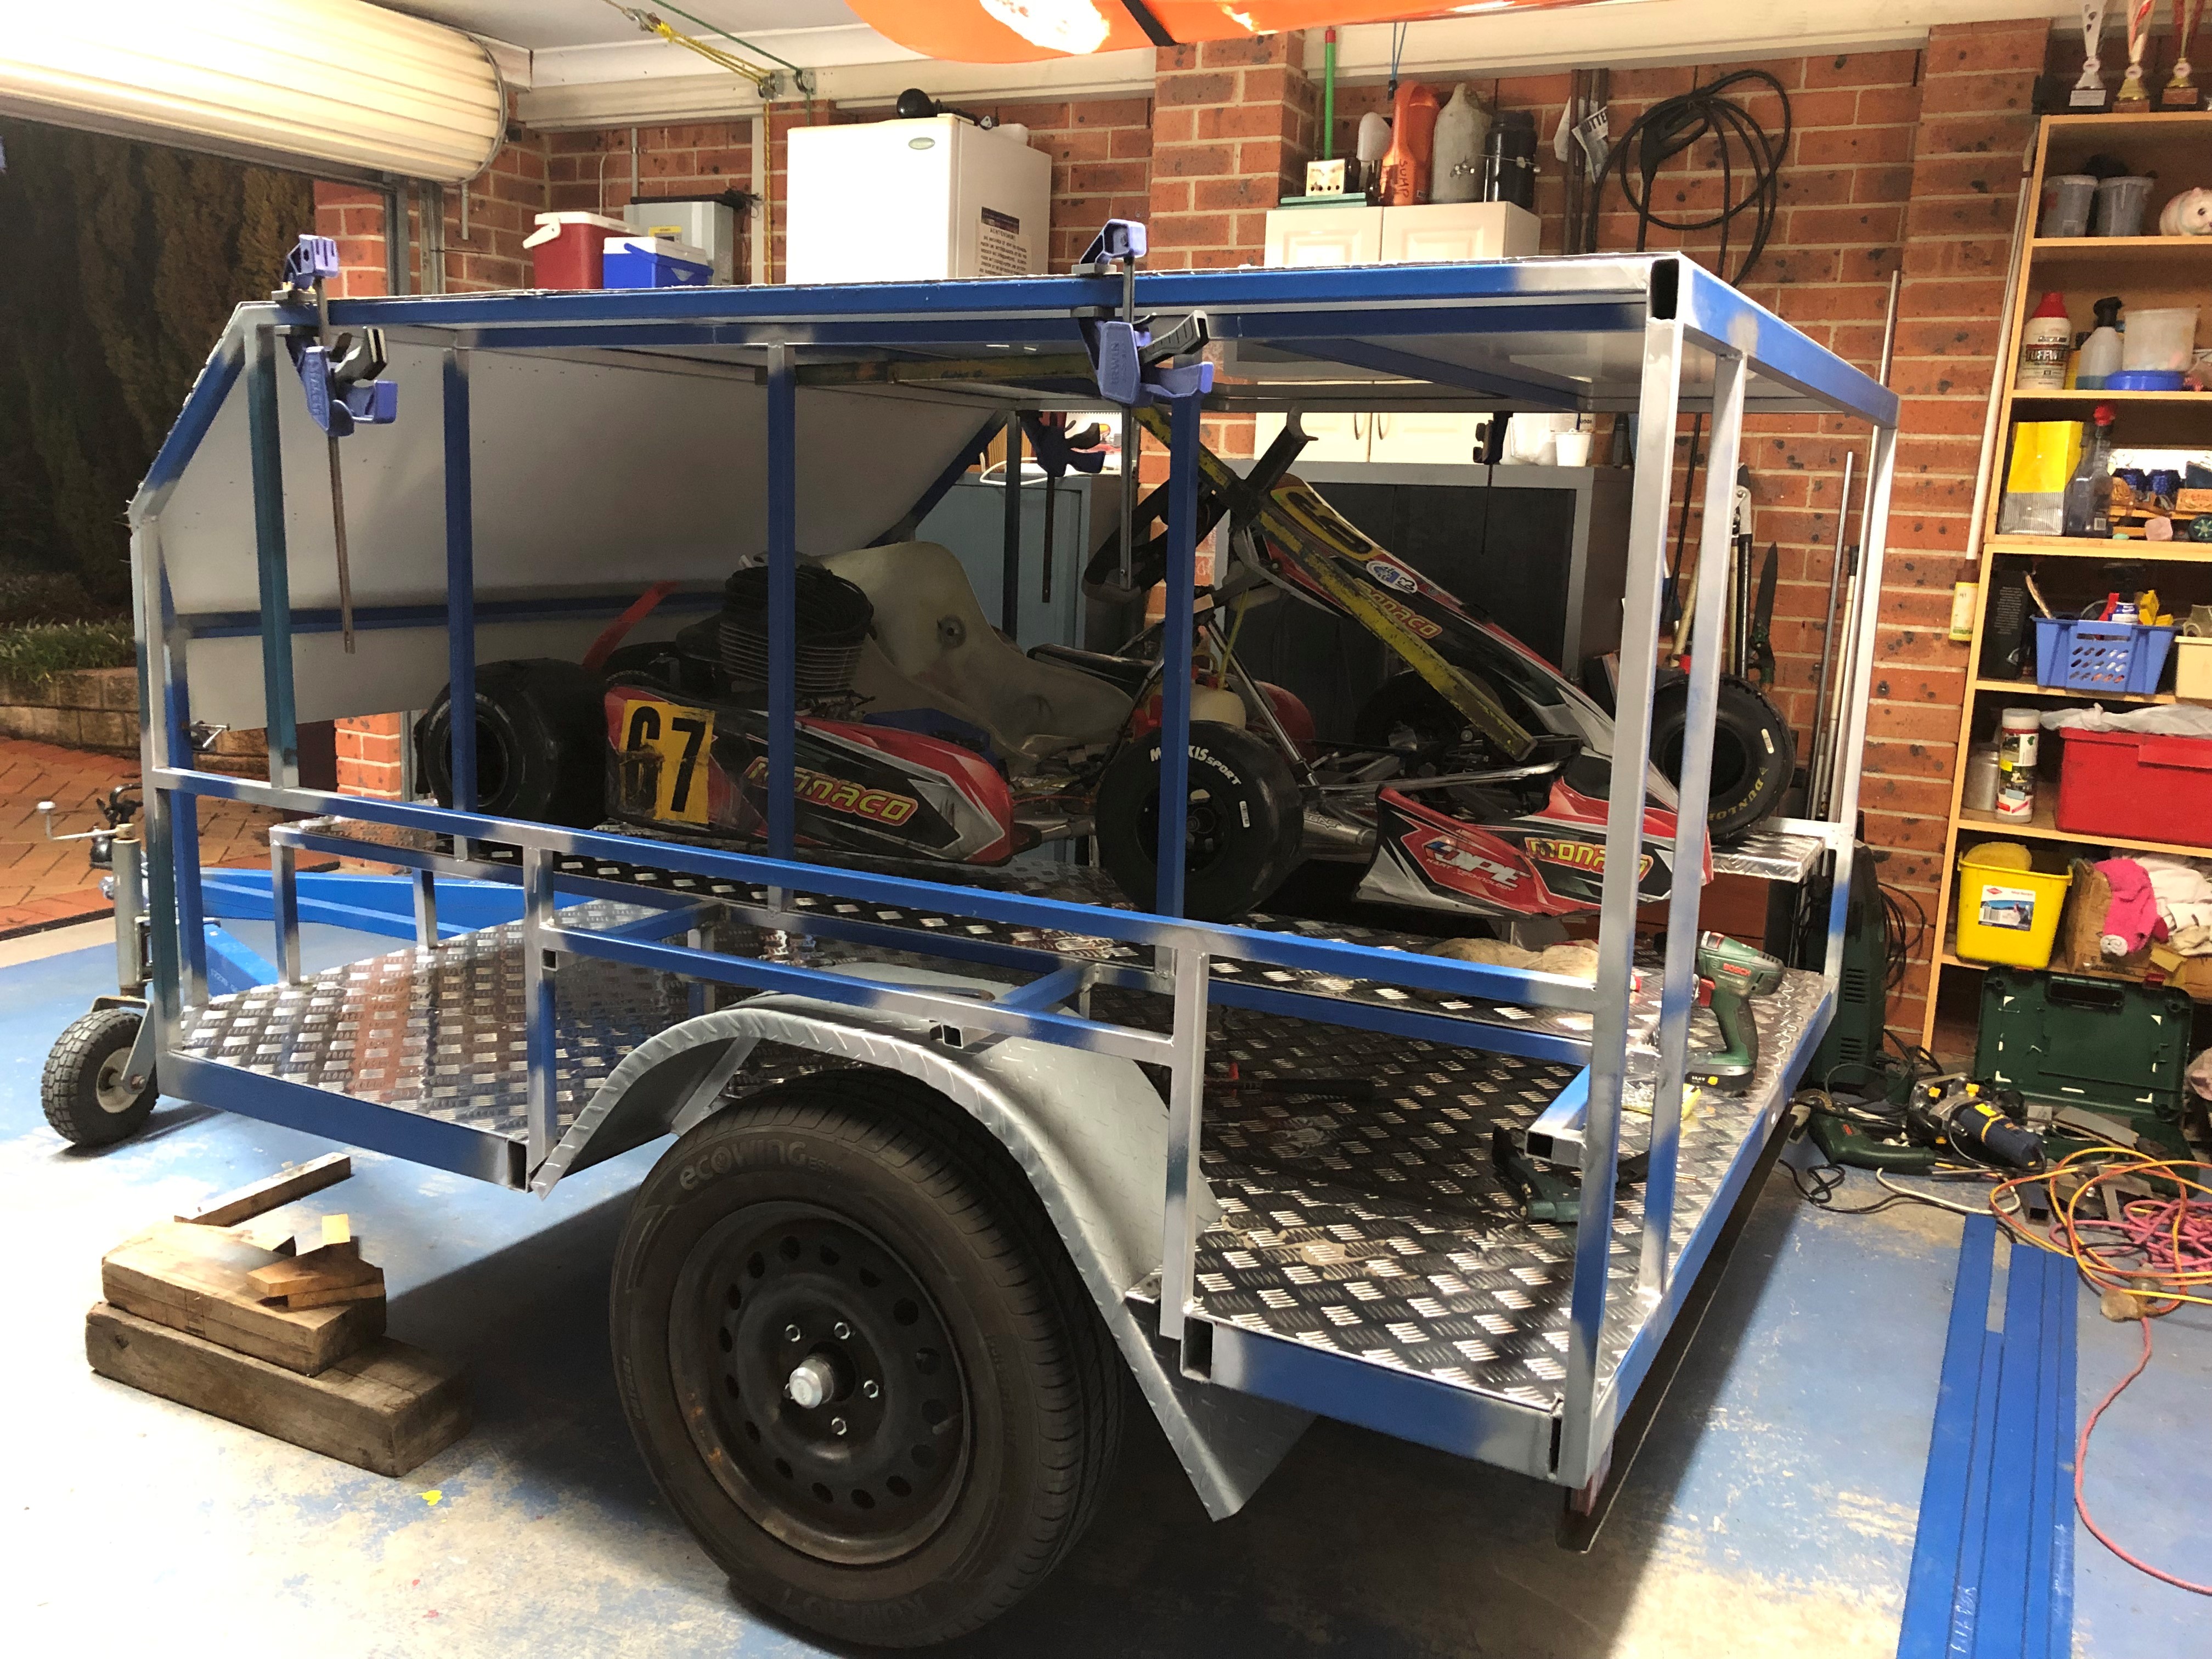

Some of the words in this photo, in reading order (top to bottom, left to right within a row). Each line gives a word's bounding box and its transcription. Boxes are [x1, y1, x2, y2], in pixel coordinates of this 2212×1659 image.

[1397, 159, 1409, 198] SUMP
[625, 706, 707, 812] 67
[1150, 744, 1209, 762] MXIS
[1205, 756, 1242, 785] SPORT
[1529, 840, 1649, 874] MONA
[1457, 868, 1519, 891] TECHNOLOGY
[1723, 962, 1752, 977] BOSCH
